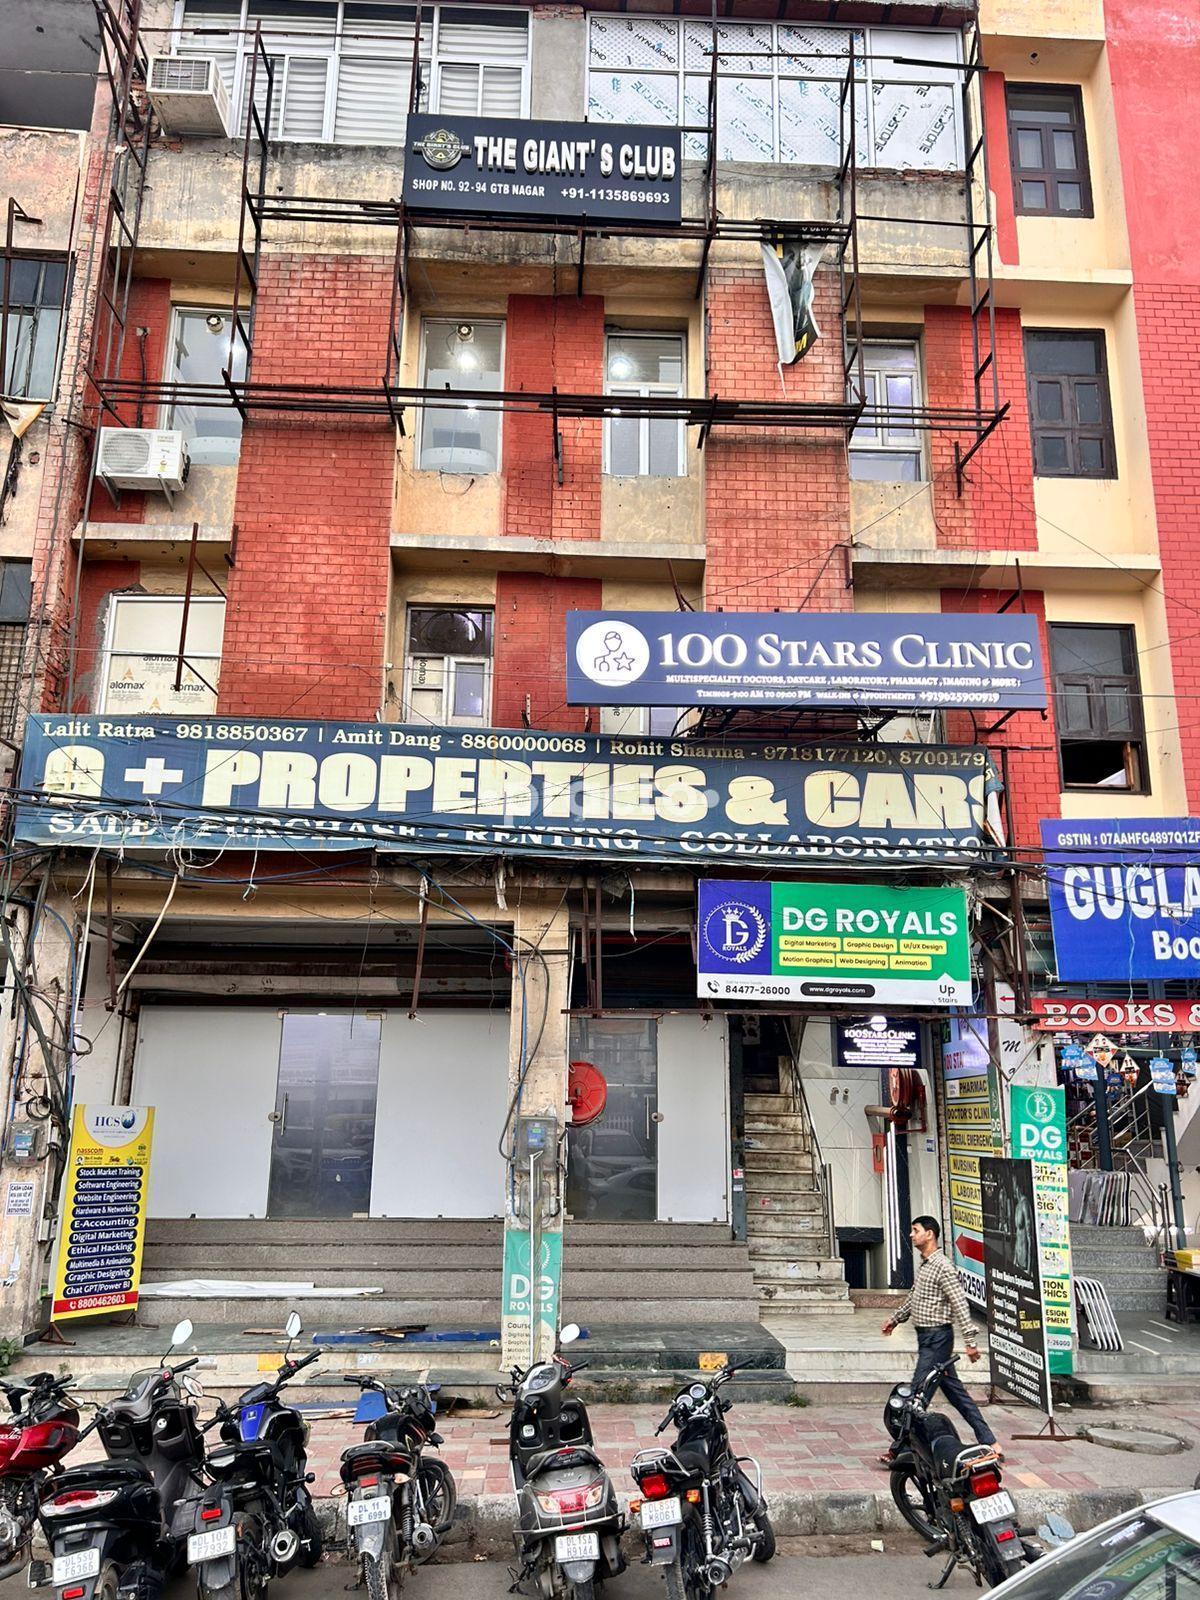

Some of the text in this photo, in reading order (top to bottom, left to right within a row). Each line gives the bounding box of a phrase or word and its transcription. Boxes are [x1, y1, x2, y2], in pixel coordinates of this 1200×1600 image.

[473, 136, 517, 170] THE
[619, 145, 676, 180] CLUB
[413, 179, 439, 190] SHOP
[441, 180, 456, 191] NO.
[490, 183, 510, 195] GTB
[512, 185, 545, 197] NAGAR
[561, 188, 670, 204] +91-1135869693
[657, 633, 748, 668] 100
[109, 681, 145, 690] alomax
[170, 683, 205, 692] aomax
[43, 721, 91, 737] Lalit
[98, 722, 156, 740] Ratra
[176, 725, 308, 743] 9818850367
[332, 728, 384, 746] Amit
[389, 731, 441, 751] Dang
[461, 733, 586, 754] 8860000068
[610, 740, 662, 757] Rohit
[670, 742, 745, 760] Sharma
[200, 748, 708, 823] PROPERTIES
[725, 775, 790, 826] &
[1058, 833, 1091, 846] GSTIN
[782, 907, 958, 936] DG ROYALS
[784, 940, 805, 949] Digital
[805, 941, 837, 950] Marketing
[846, 941, 868, 951] Graphic
[869, 942, 894, 951] Design
[921, 943, 943, 952] Design
[804, 956, 833, 966] Graphics
[839, 957, 852, 965] Web
[853, 958, 886, 967] Designing
[895, 959, 927, 967] Animation
[725, 984, 790, 996] 84477-26000
[939, 985, 956, 996] Up
[1043, 1002, 1176, 1027] BOOKS
[1020, 1124, 1062, 1149] DG
[1020, 1149, 1063, 1160] ROYALS
[80, 1168, 96, 1176] Stock
[119, 1167, 140, 1177] Training
[78, 1180, 139, 1190] Software Engineering
[78, 1192, 138, 1203] Website Engineering
[76, 1206, 101, 1215] Hardware
[107, 1205, 136, 1214] Networking
[74, 1218, 135, 1229] E-Accounting
[72, 1230, 134, 1243] Digital Marketing
[71, 1243, 133, 1255] Ethical Hacking
[69, 1259, 100, 1269] Multimedia
[105, 1257, 132, 1266] Animation
[69, 1269, 130, 1283] Graphic Designing
[66, 1286, 83, 1296] Chat
[77, 1294, 126, 1309] 8800462603
[359, 1502, 380, 1513] DL 11
[353, 1510, 387, 1524] SE 6991
